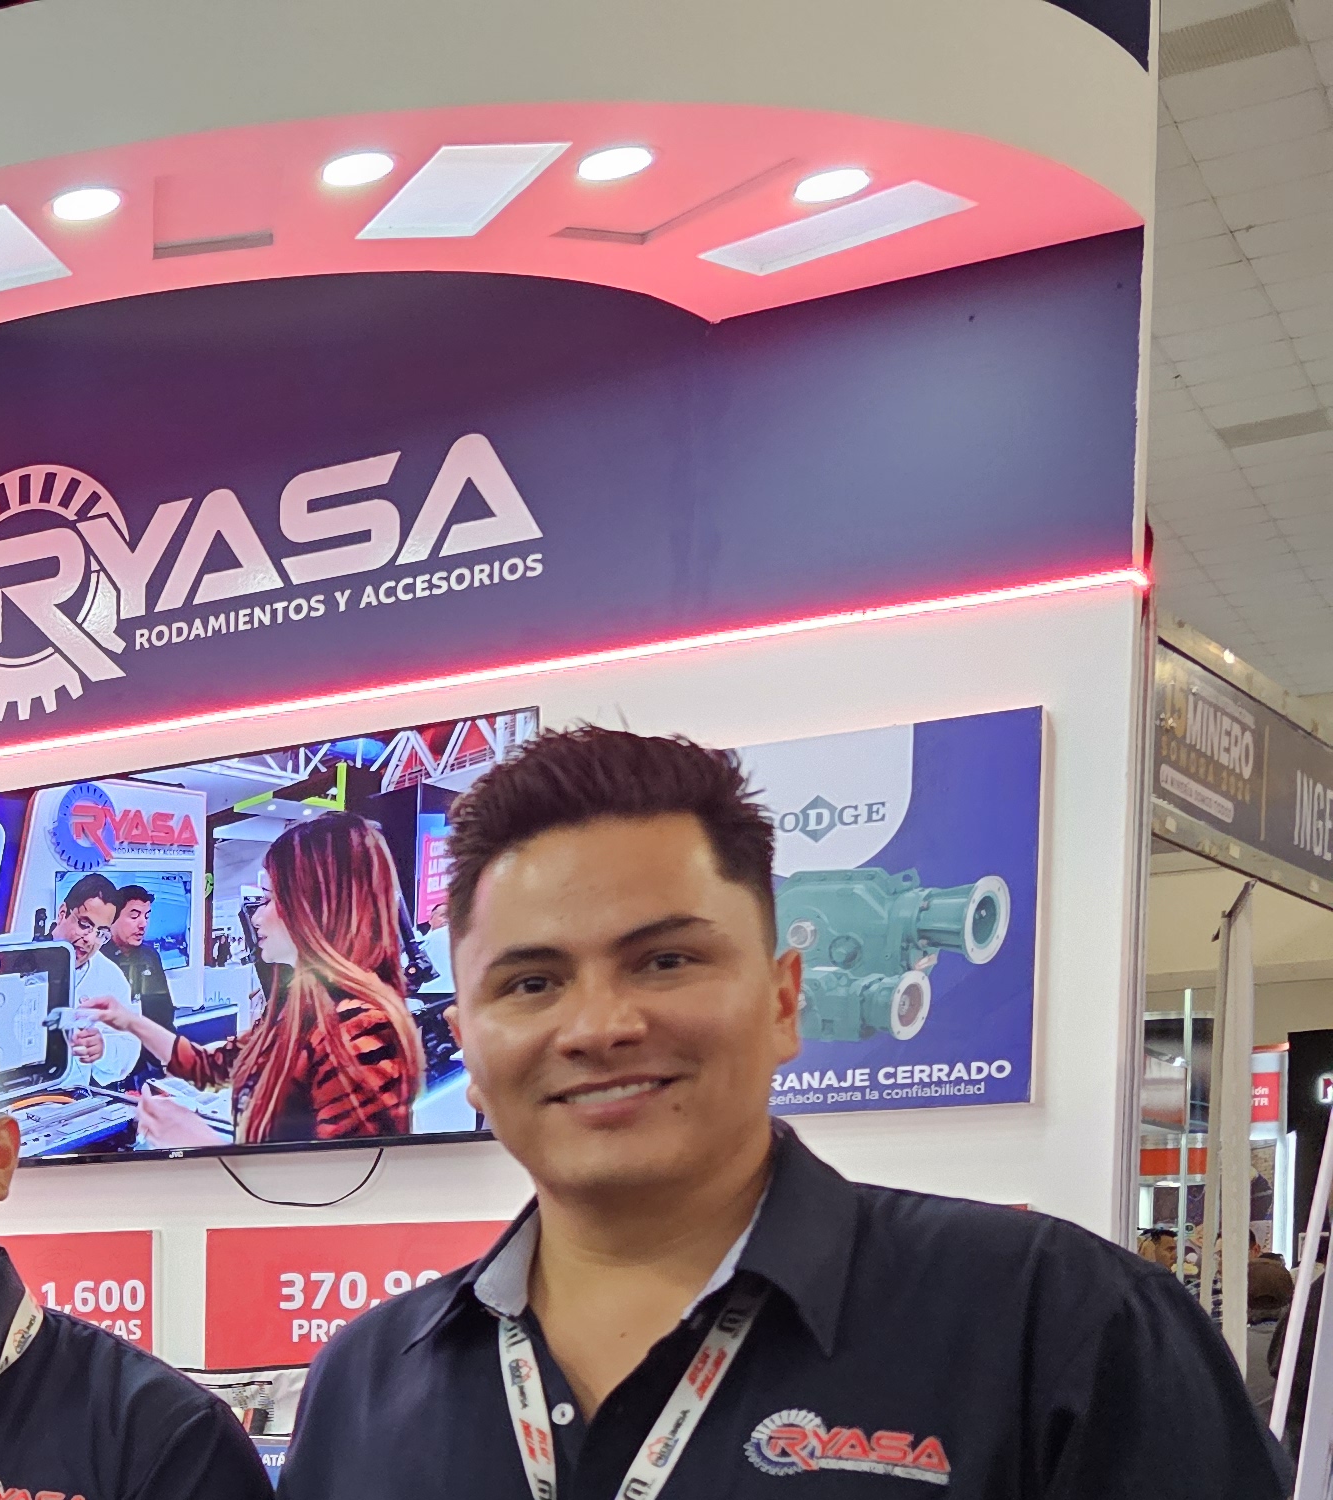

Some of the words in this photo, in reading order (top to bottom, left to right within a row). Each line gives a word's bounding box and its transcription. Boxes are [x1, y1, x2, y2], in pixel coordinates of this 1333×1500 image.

[134, 596, 326, 651] RODAMIENTOS
[334, 588, 353, 614] Y
[359, 553, 544, 610] ACCESORIOS
[1186, 694, 1253, 779] MINERO
[71, 804, 199, 861] RYASA
[779, 801, 886, 833] ODGE
[1293, 769, 1333, 861] INGE
[768, 1091, 823, 1107] señado
[827, 1092, 861, 1105] para
[865, 1088, 879, 1100] la
[882, 1082, 985, 1100] confiabilidad
[771, 1067, 870, 1092] RANAJE
[878, 1060, 1012, 1086] CERRADO
[262, 1452, 286, 1468] ATÁ
[769, 1425, 952, 1473] RYASA
